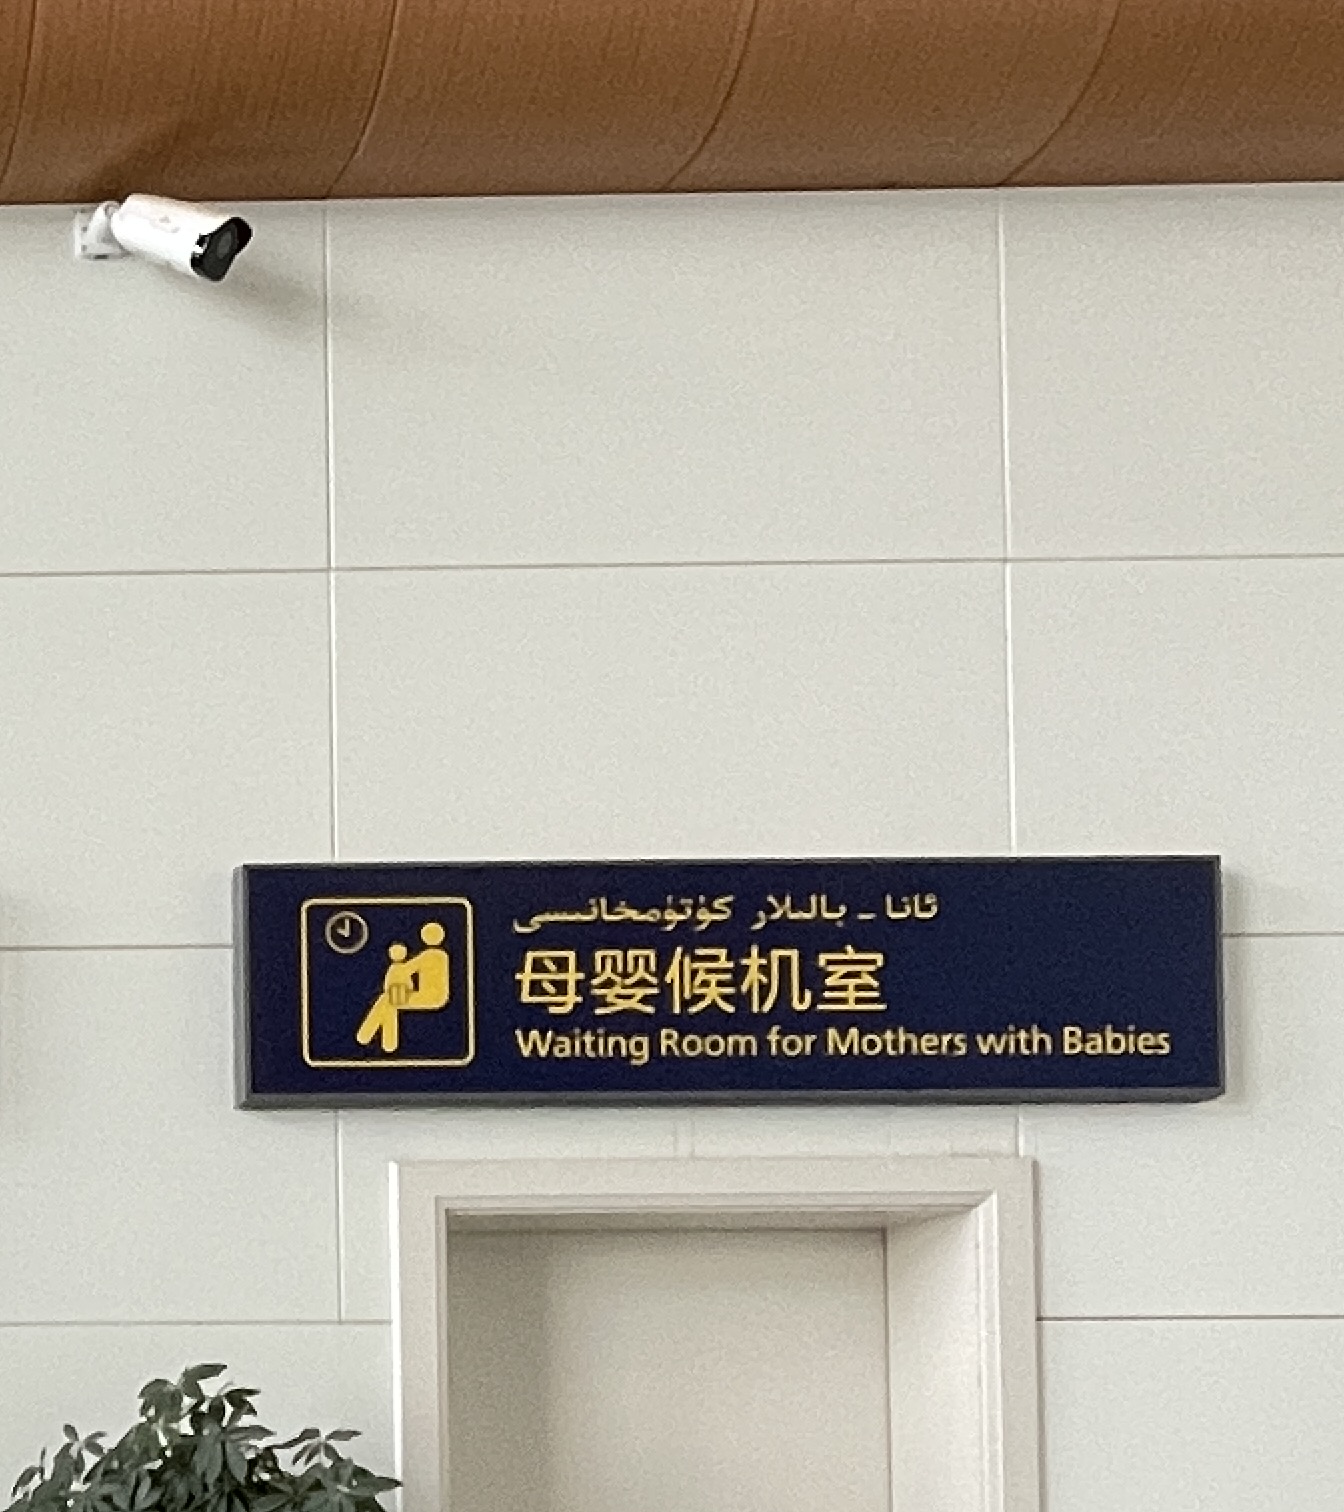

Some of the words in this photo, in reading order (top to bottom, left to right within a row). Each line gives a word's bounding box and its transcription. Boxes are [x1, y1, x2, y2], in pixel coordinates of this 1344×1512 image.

[513, 943, 889, 1017] 母婴候机室
[513, 1027, 652, 1067] Waiting
[659, 1027, 759, 1058] Room
[765, 1023, 819, 1058] for
[825, 1023, 969, 1057] Mothers
[975, 1023, 1053, 1057] with
[1061, 1022, 1172, 1057] Babies
